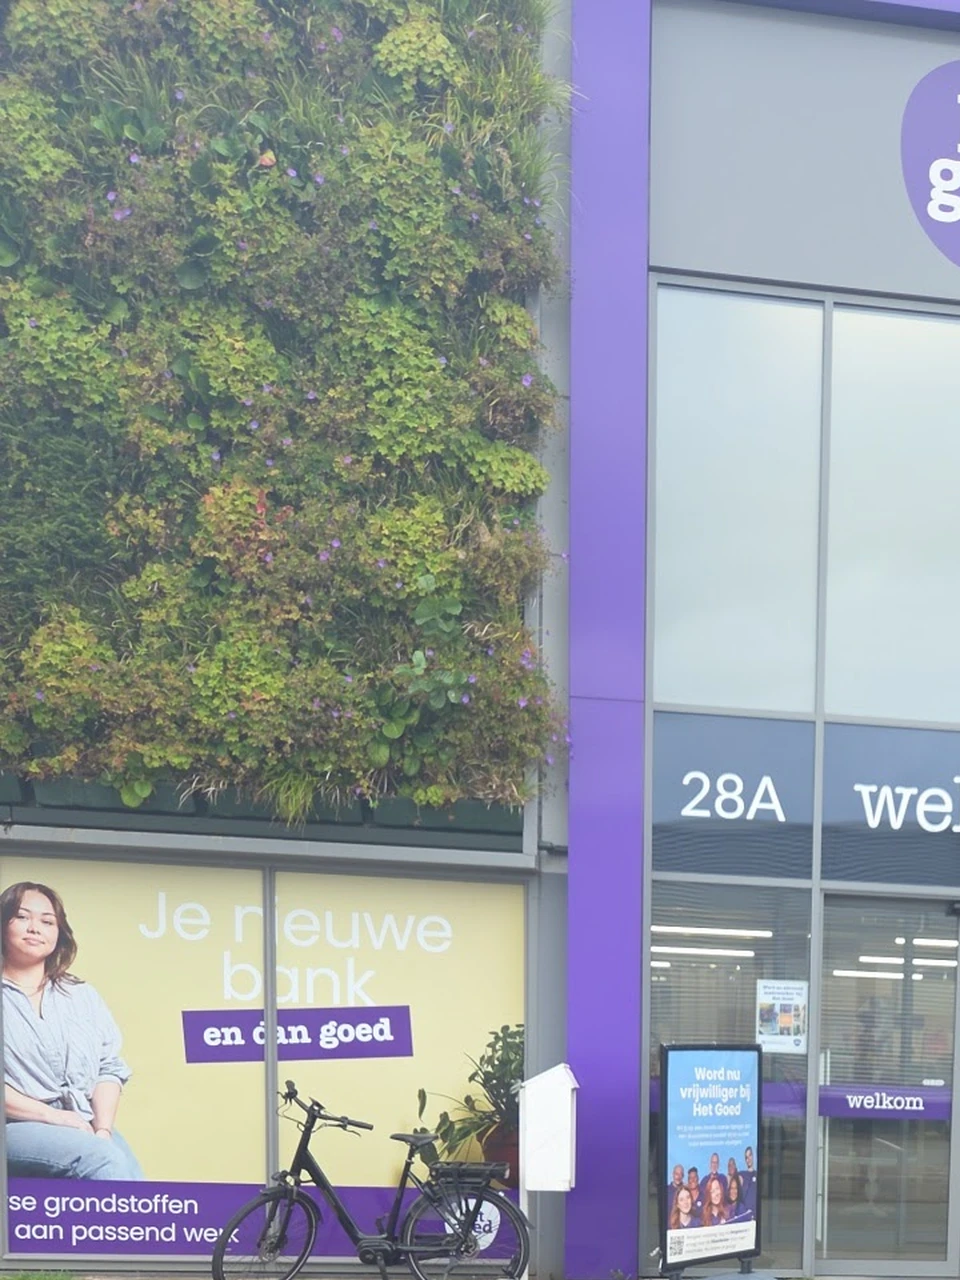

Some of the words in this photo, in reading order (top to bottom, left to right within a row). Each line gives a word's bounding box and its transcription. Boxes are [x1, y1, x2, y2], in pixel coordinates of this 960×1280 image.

[681, 771, 786, 822] 28A
[139, 892, 212, 941] Je
[223, 950, 377, 1007] bank
[203, 1025, 245, 1046] en
[319, 1017, 395, 1049] goed
[694, 1067, 725, 1081] Word
[727, 1069, 741, 1081] nu
[680, 1083, 738, 1103] vrijwilliger
[739, 1083, 751, 1102] bij
[847, 1092, 924, 1110] welkom
[693, 1102, 713, 1116] Het
[715, 1101, 741, 1116] Goed
[44, 1193, 198, 1218] grondstoffen
[14, 1223, 64, 1240] aan
[71, 1222, 176, 1246] passend
